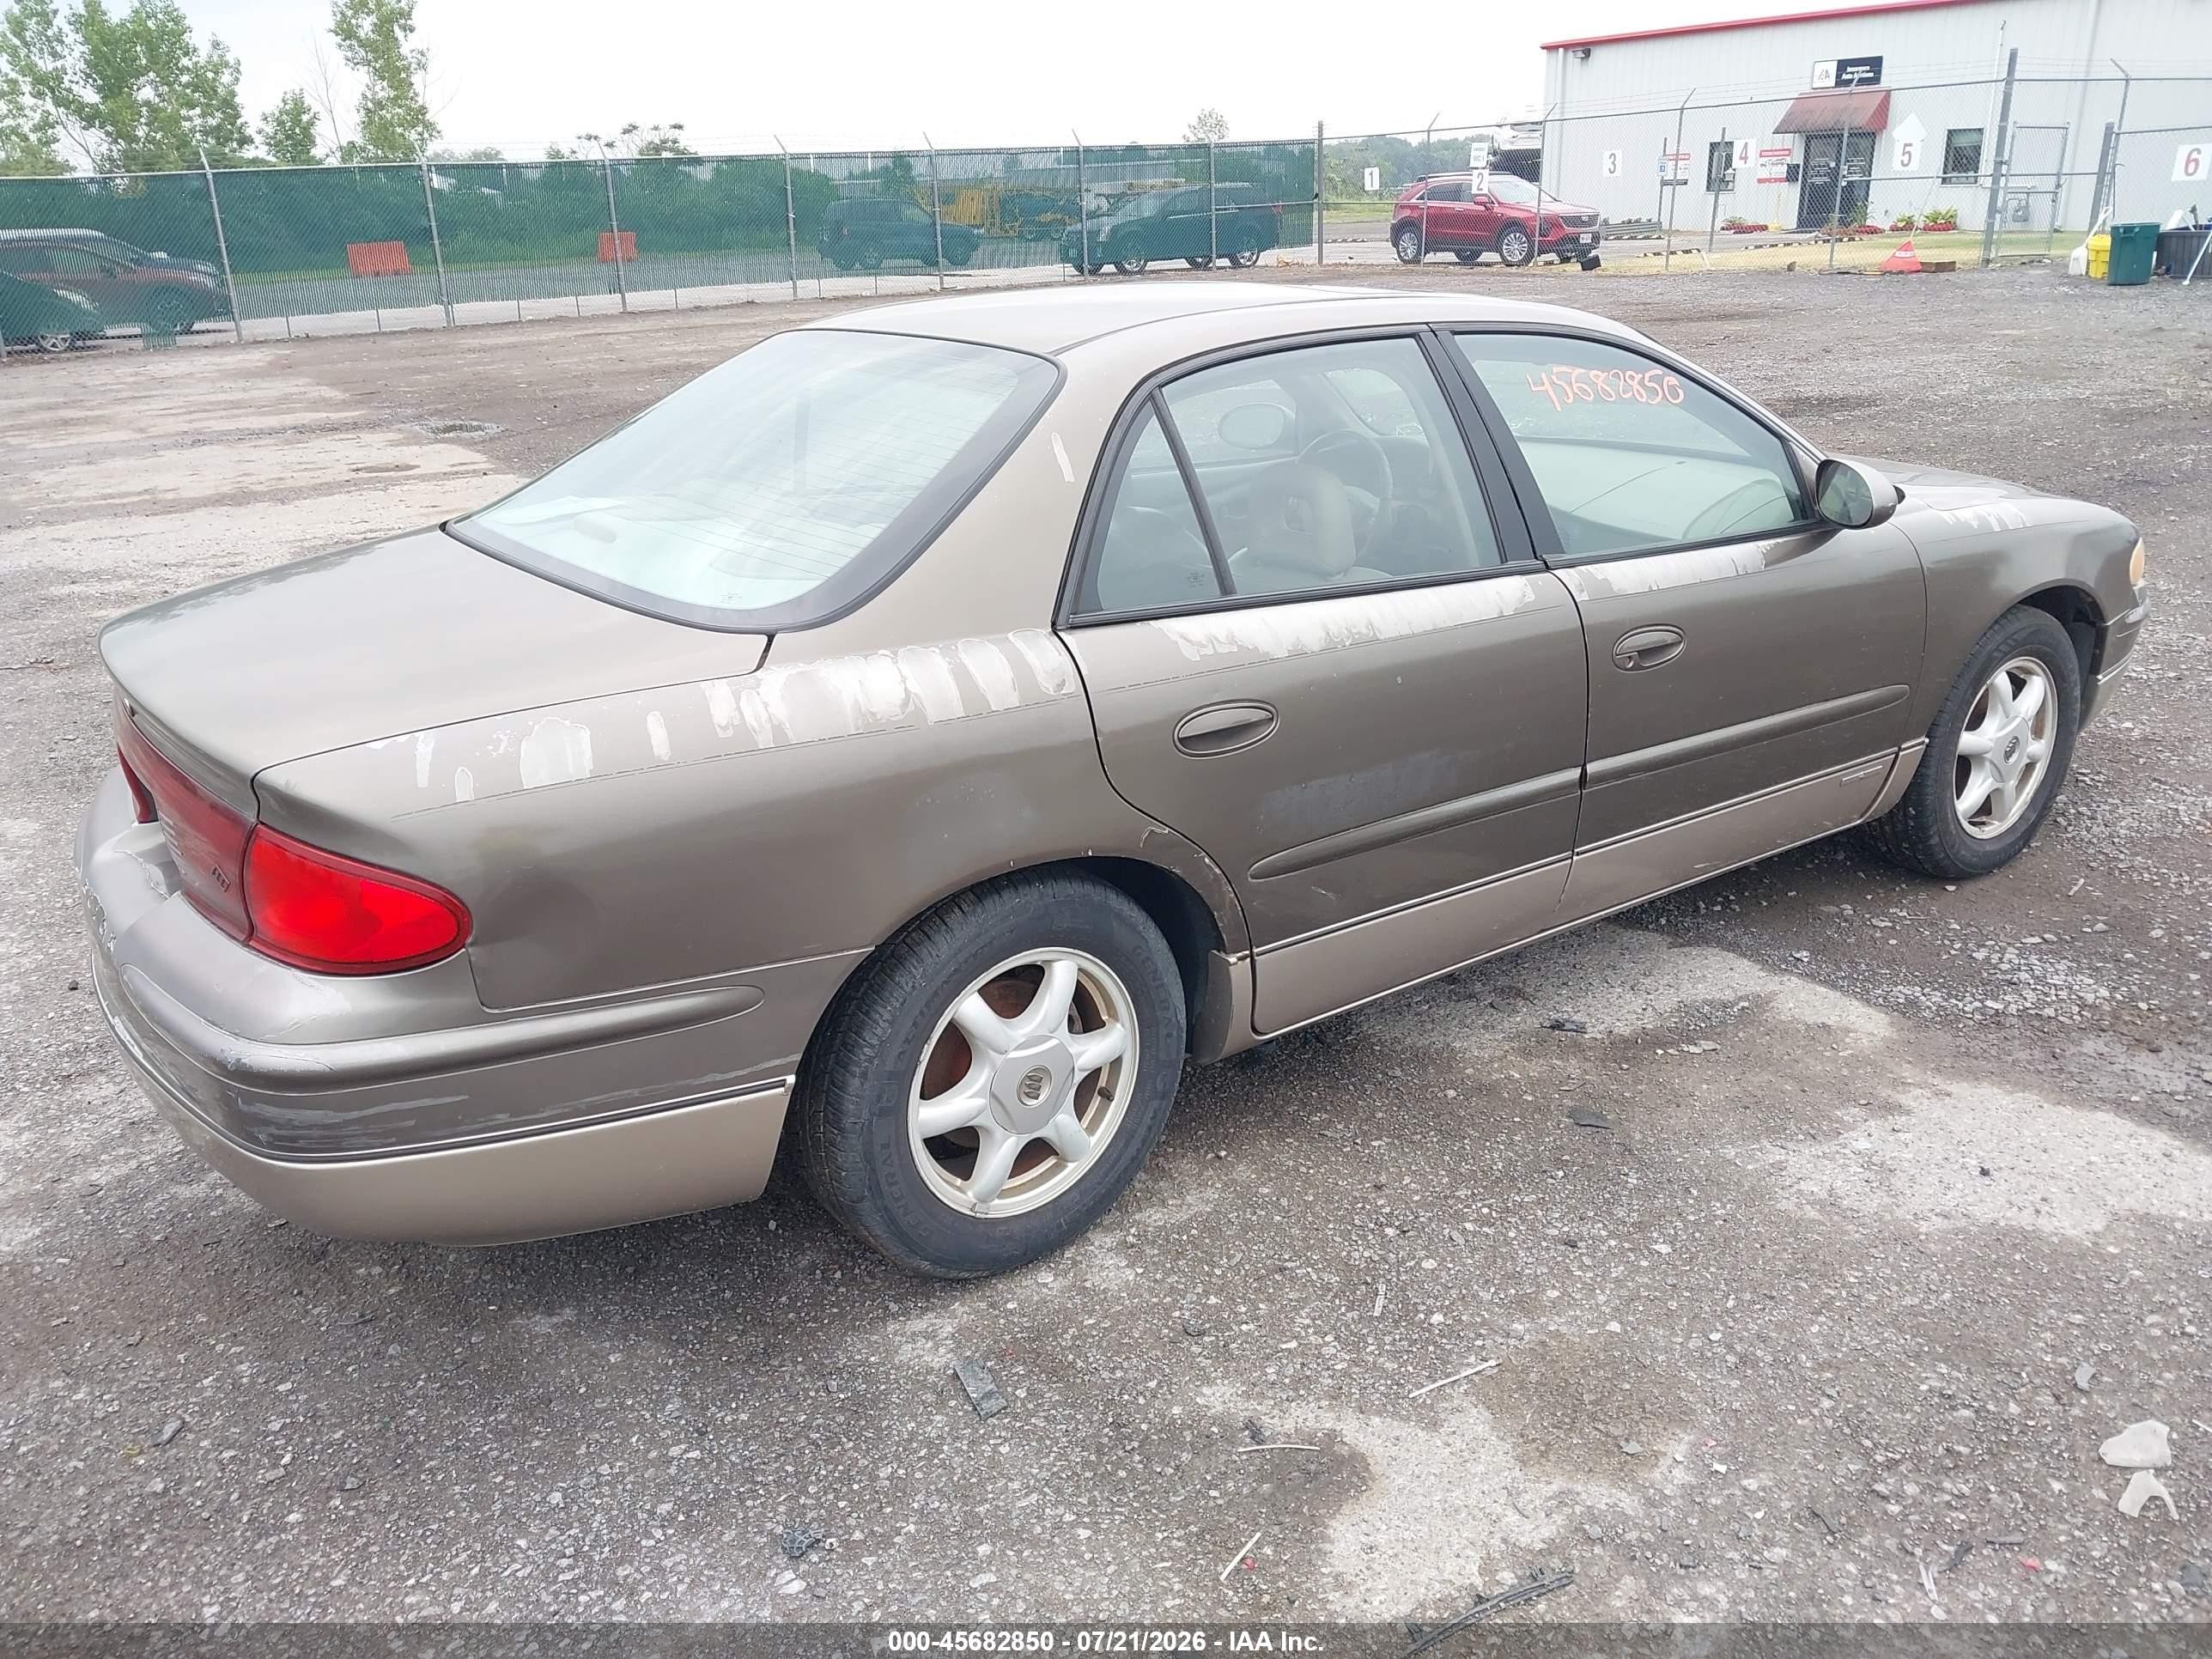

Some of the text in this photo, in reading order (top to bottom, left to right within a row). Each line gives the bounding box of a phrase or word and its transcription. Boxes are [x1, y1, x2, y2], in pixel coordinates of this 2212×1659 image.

[1608, 153, 1617, 174] 3
[1739, 142, 1749, 165] 4
[1900, 143, 1913, 167] 5
[2184, 148, 2202, 177] 6
[1369, 169, 1374, 189] 1
[1476, 172, 1484, 191] 2
[1525, 364, 1685, 412] 45682850
